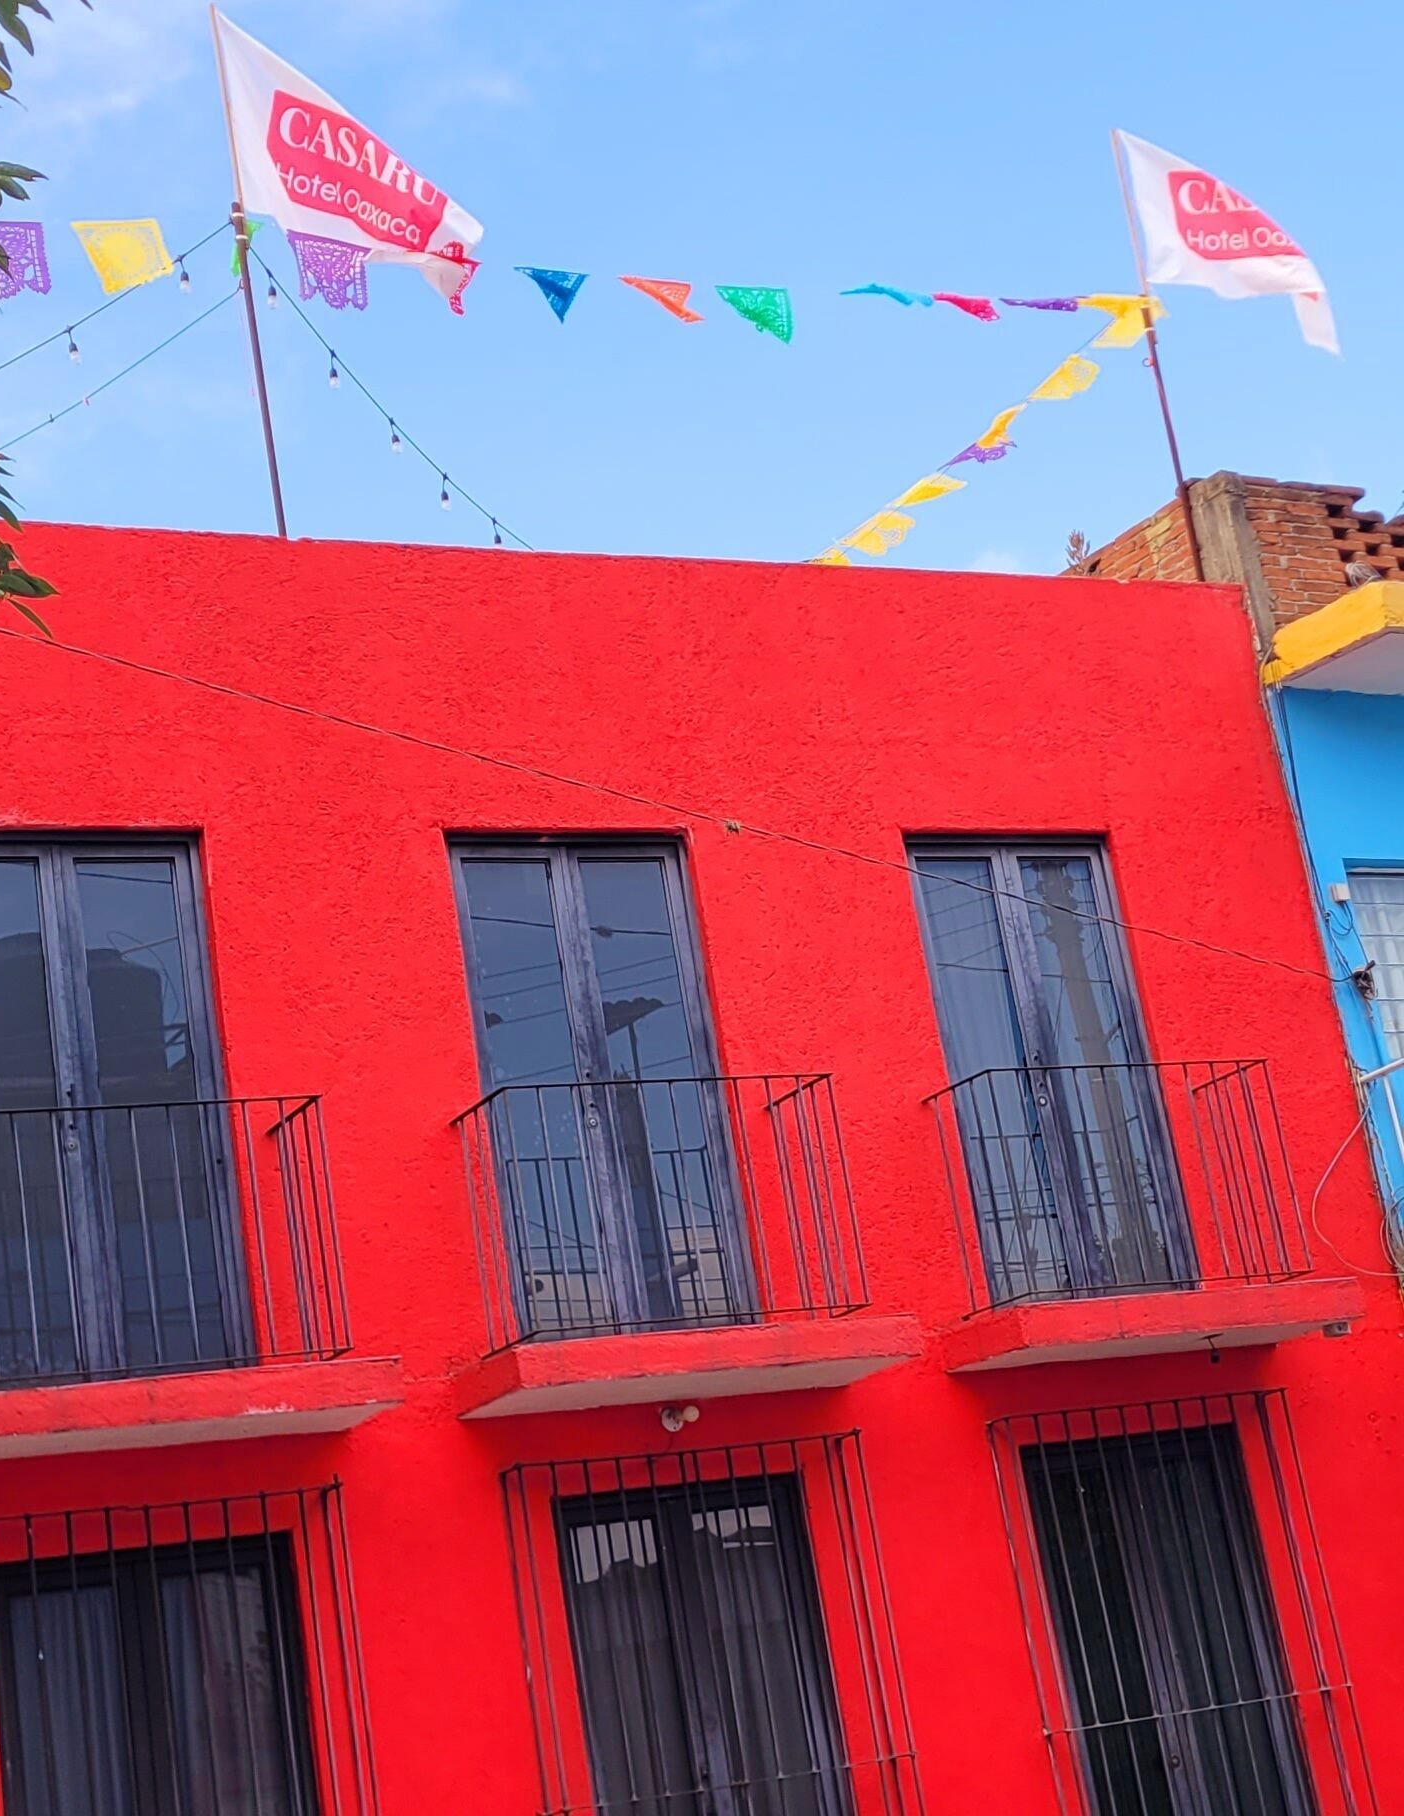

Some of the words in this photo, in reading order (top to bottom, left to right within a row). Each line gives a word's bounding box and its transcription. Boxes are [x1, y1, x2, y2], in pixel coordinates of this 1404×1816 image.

[275, 161, 342, 205] Hotel
[343, 188, 422, 246] Oaxaca
[1186, 228, 1249, 251] Hotel
